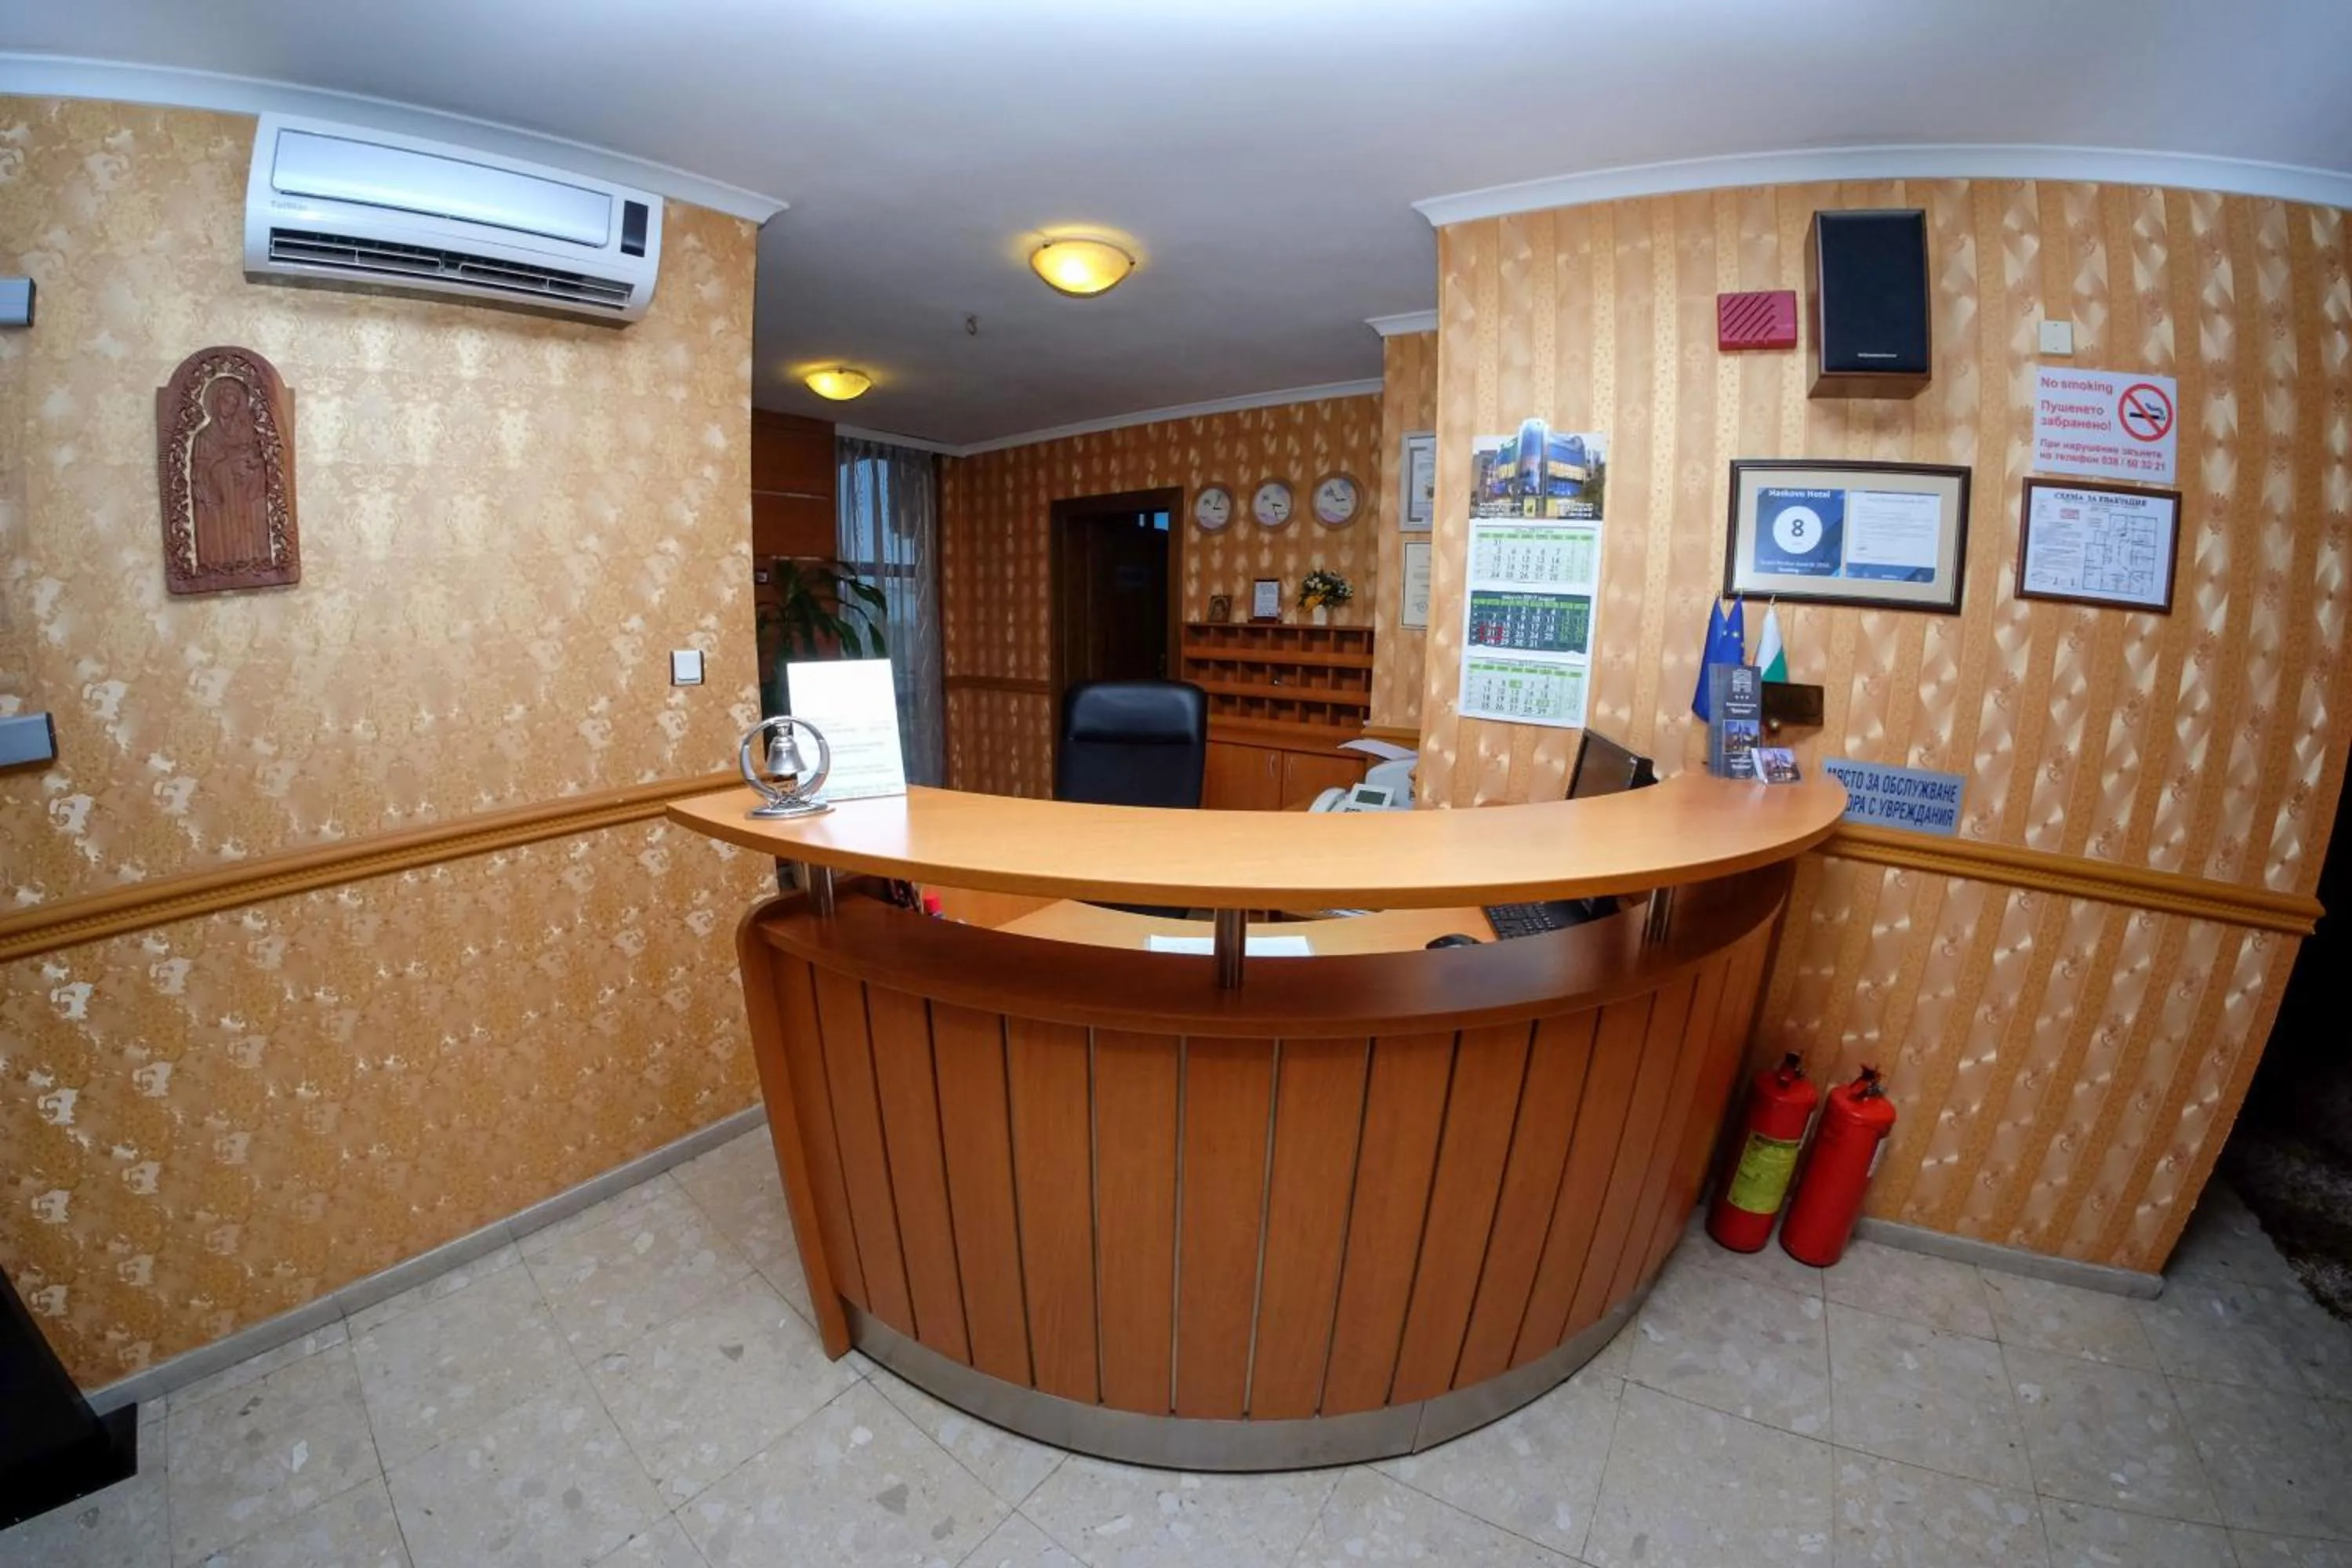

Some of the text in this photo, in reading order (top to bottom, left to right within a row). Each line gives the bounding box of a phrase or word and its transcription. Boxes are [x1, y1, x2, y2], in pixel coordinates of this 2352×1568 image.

[2041, 377, 2113, 395] No smoking
[2041, 400, 2104, 416] Пушенето
[2041, 416, 2111, 430] забранено!
[1791, 519, 1804, 537] 8
[1828, 768, 1957, 804] ЯСТО ЗА ОБСЛУЖВАНЕ
[1846, 793, 1955, 826] ОРА С УВРЕЖДАНИЯ
